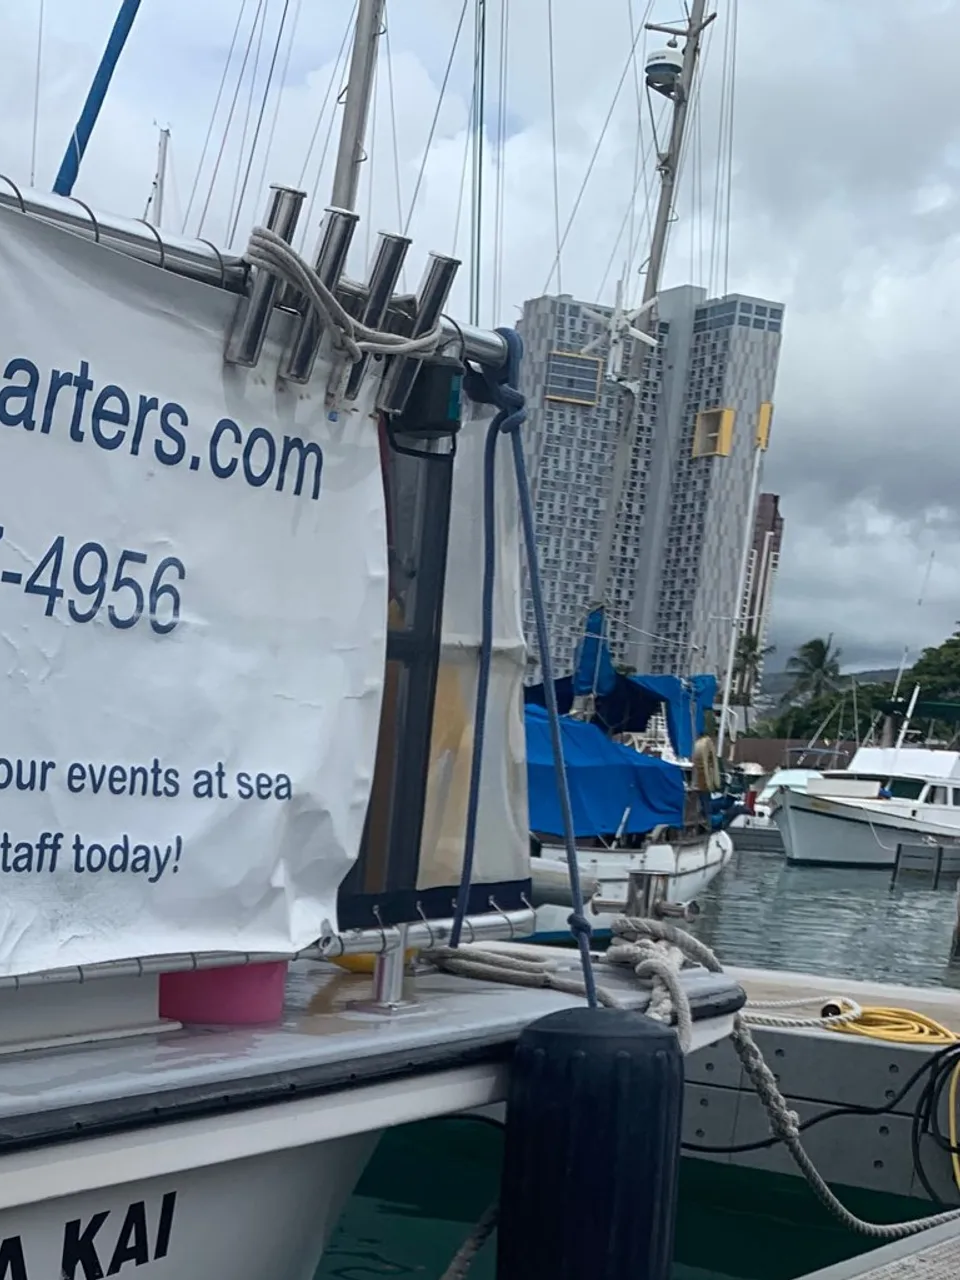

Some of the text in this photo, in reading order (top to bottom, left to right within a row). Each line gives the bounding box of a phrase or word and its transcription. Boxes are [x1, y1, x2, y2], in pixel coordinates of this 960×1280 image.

[67, 758, 180, 799] events
[193, 762, 228, 799] at
[237, 772, 293, 801] sea
[73, 833, 183, 885] today!
